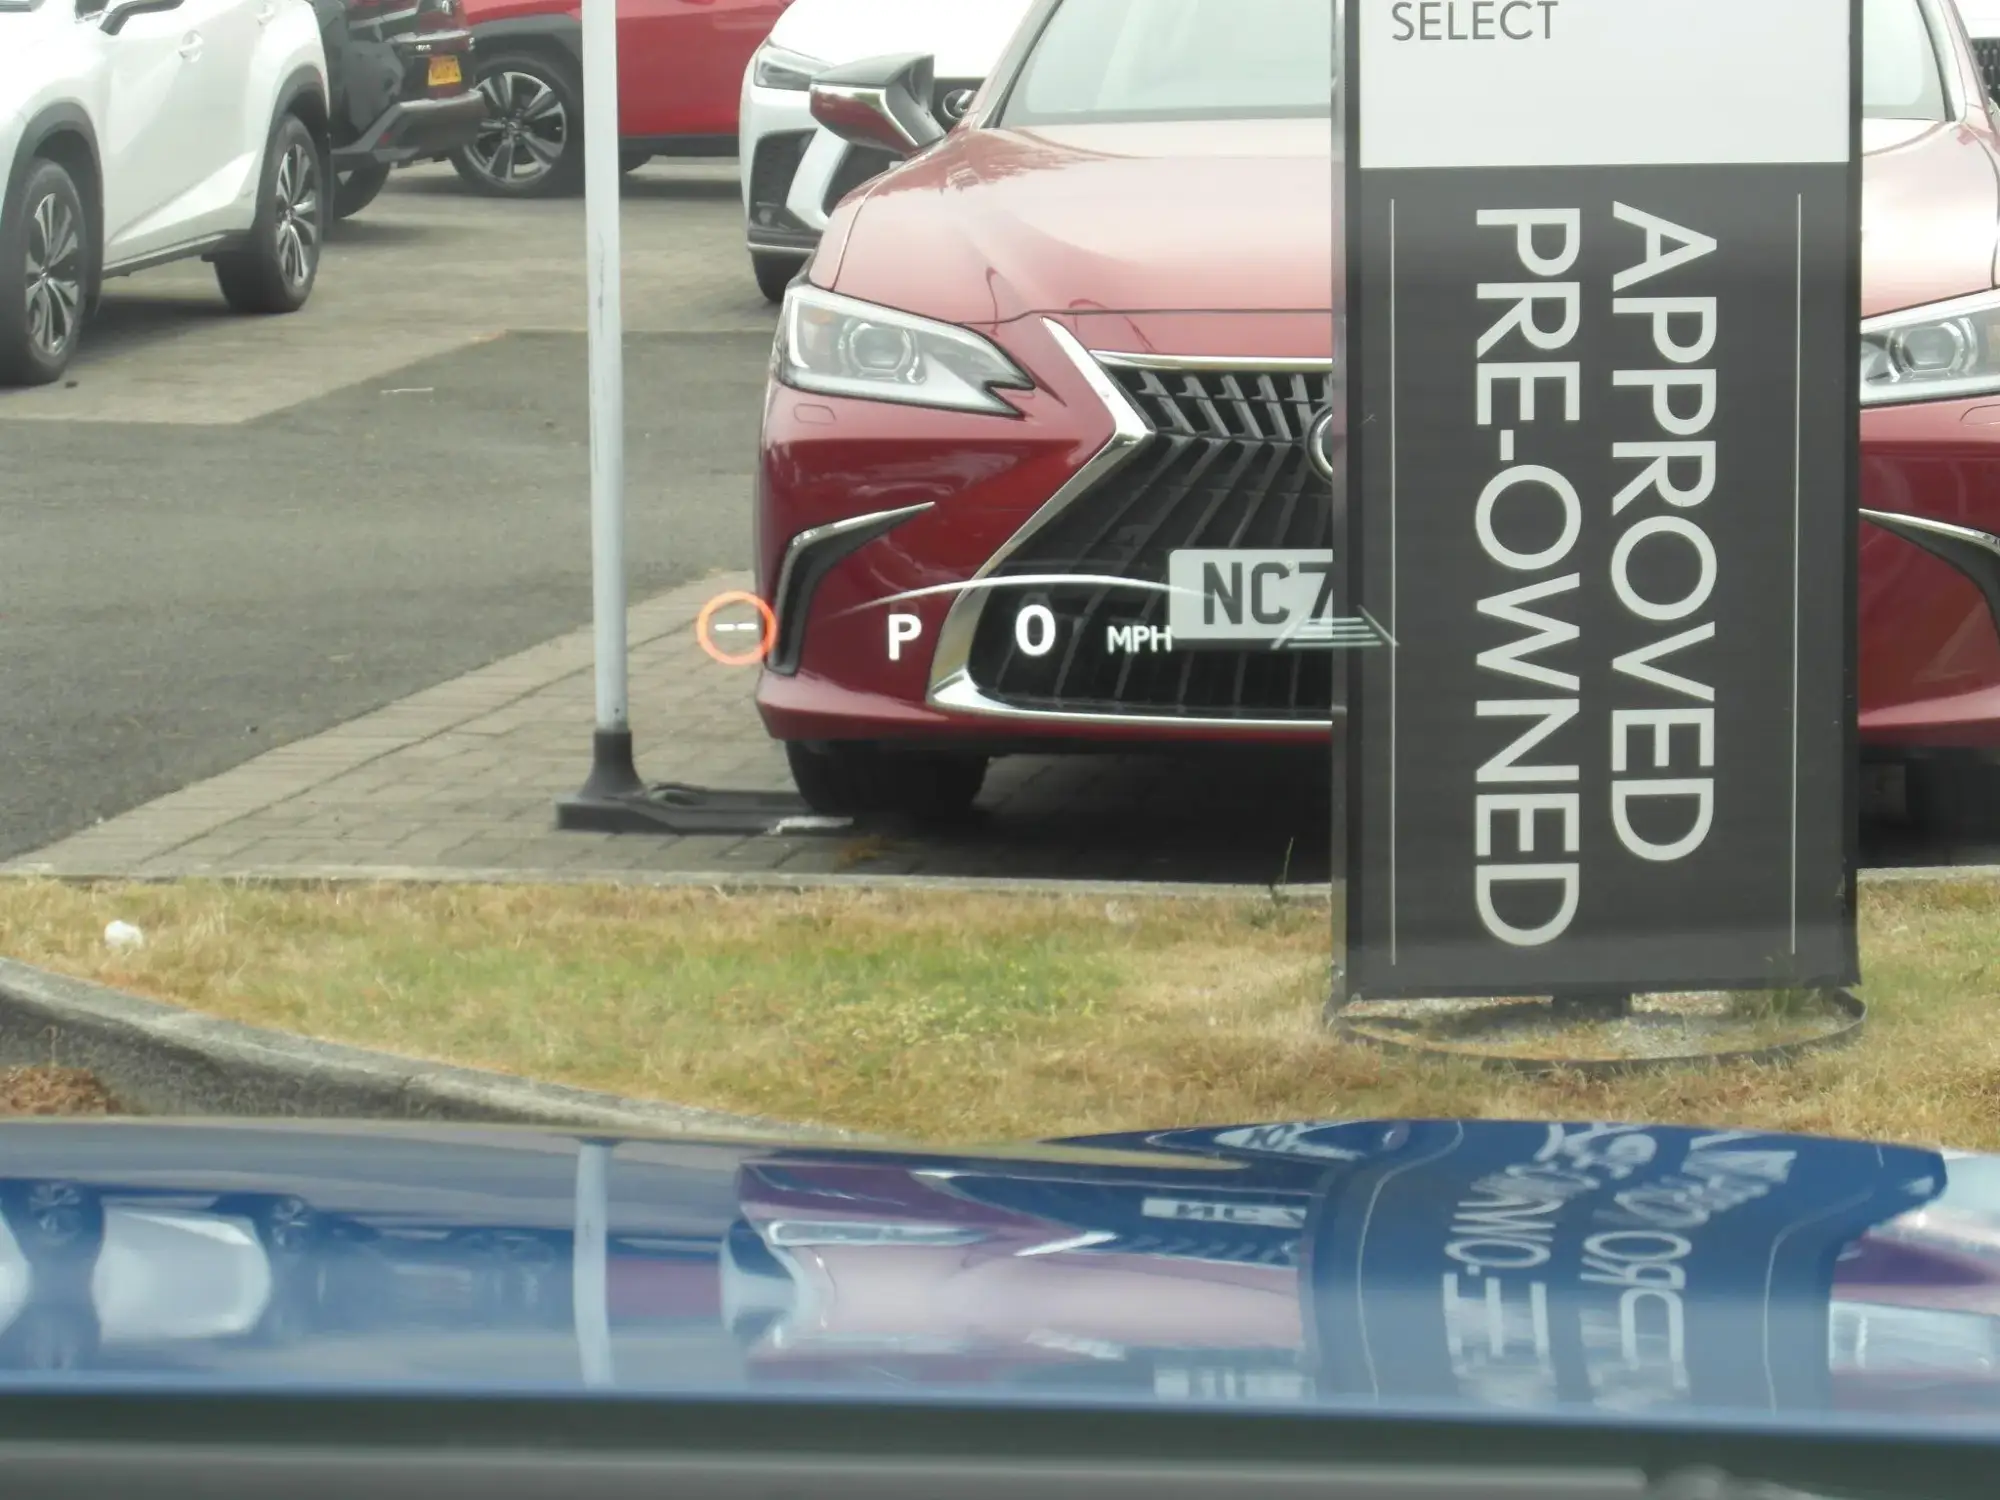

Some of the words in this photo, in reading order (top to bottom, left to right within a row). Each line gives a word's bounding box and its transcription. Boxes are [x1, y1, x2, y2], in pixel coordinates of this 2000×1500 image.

[1391, 0, 1559, 41] SELECT
[888, 613, 922, 660] P
[1107, 624, 1173, 654] MPH
[1475, 207, 1582, 947] PRE-OWNED
[1611, 200, 1718, 862] APPROVED
